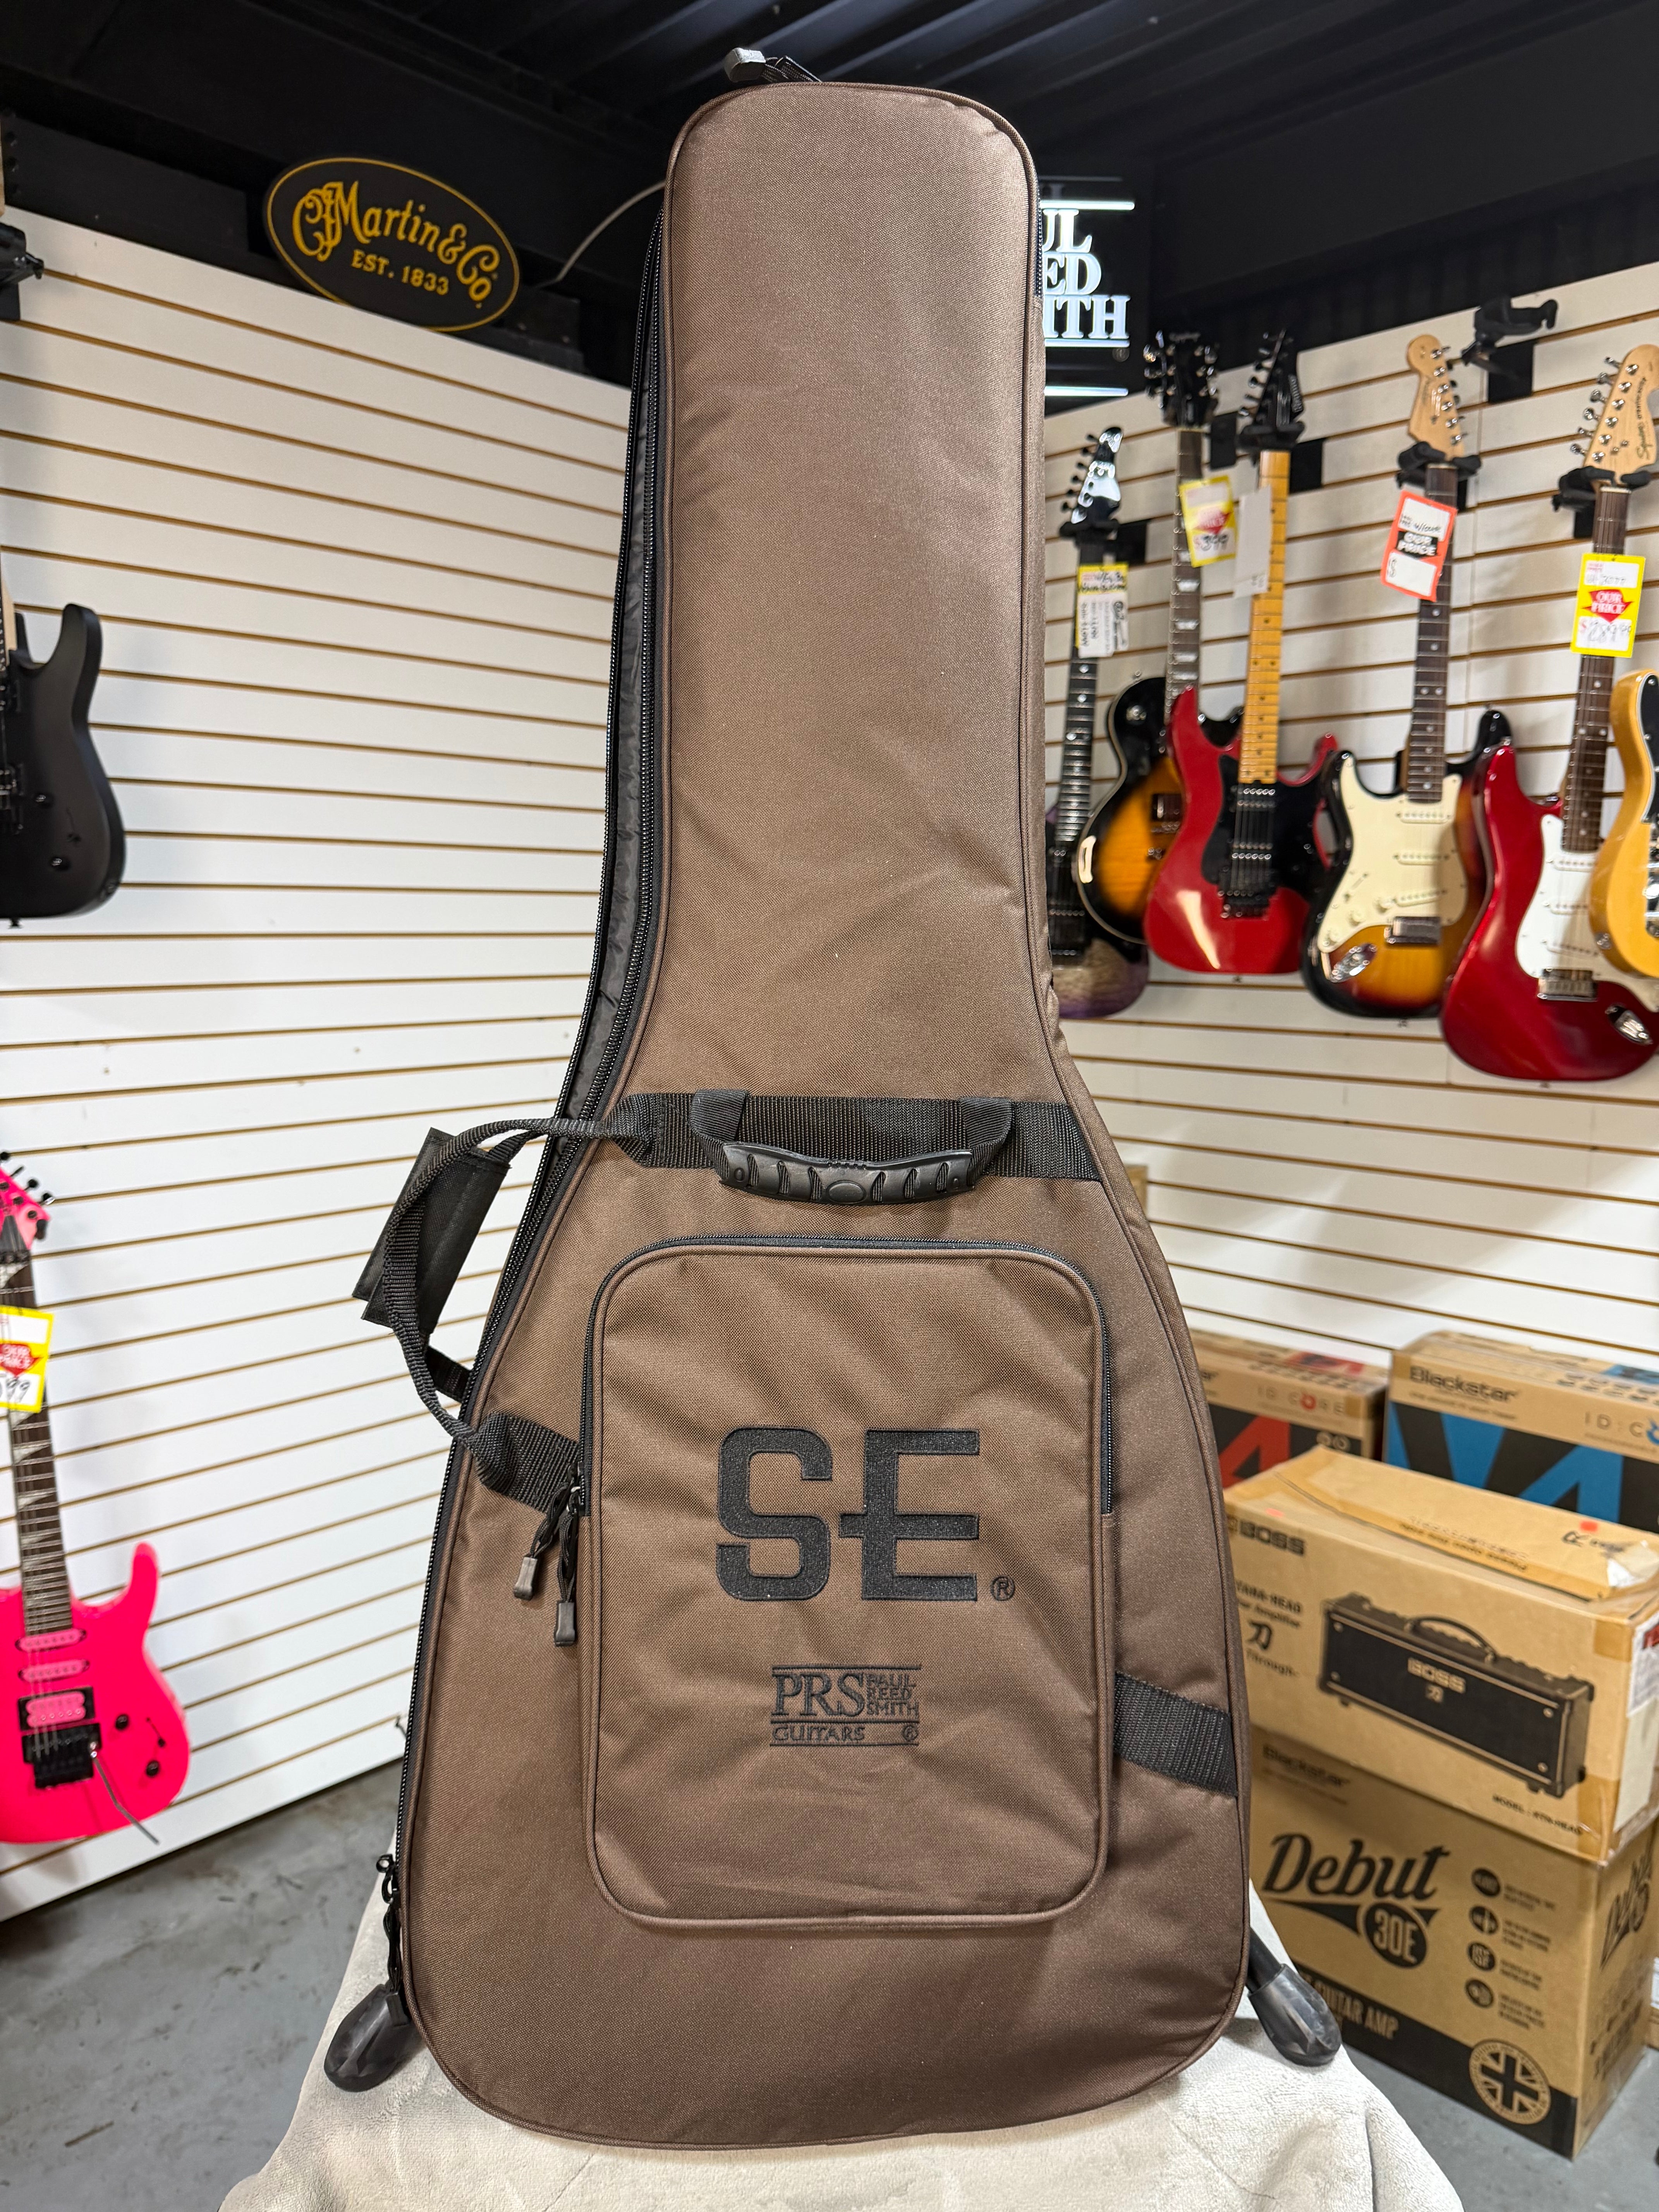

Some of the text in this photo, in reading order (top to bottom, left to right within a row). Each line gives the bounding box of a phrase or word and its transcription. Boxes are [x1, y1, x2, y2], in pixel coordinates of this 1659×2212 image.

[352, 249, 449, 295] EST. 1833
[1042, 253, 1102, 295] ED
[1042, 294, 1131, 339] ITH
[1396, 540, 1437, 556] PRICE
[1590, 602, 1626, 614] PRICE
[1595, 591, 1623, 605] OUR
[1410, 1365, 1520, 1403] Blackstar
[716, 1426, 980, 1601] SE
[1240, 1520, 1305, 1556] BOSS
[866, 1674, 916, 1688] PAUL
[866, 1688, 912, 1700] REED
[1408, 1657, 1466, 1694] BOSS
[771, 1673, 865, 1717] PRS
[866, 1701, 919, 1718] SMITH
[772, 1726, 865, 1741] GUITARS
[1262, 1832, 1451, 1901] Debut
[1373, 1908, 1418, 1965] 30E
